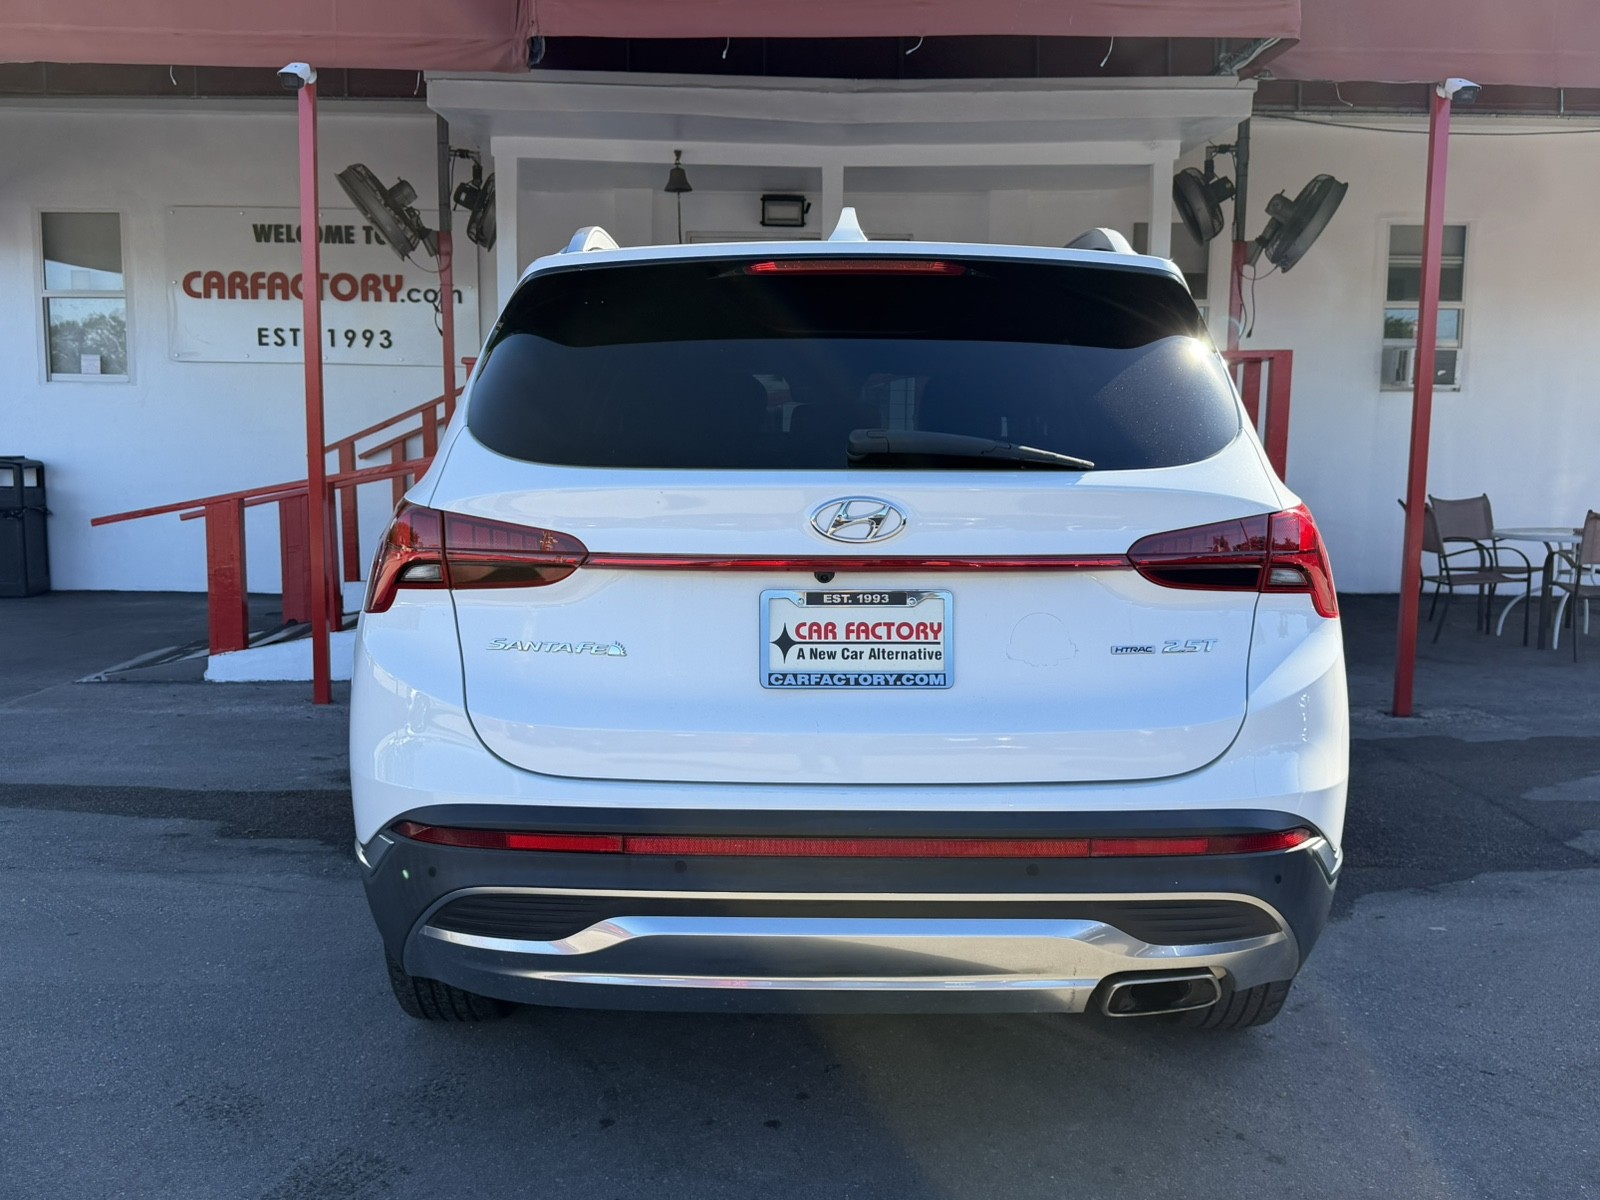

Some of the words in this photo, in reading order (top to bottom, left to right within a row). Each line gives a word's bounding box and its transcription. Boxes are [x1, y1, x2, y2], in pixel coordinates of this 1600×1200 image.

[252, 223, 355, 244] WELME
[327, 328, 393, 349] 1993
[823, 594, 852, 603] EST.
[856, 594, 889, 603] 1993
[795, 622, 838, 640] CAR
[845, 622, 942, 640] FACTORY
[797, 648, 805, 660] A
[809, 648, 837, 660] New
[841, 648, 864, 660] Car
[868, 647, 942, 660] Alternative
[769, 674, 945, 686] CARFACTORY.COM
